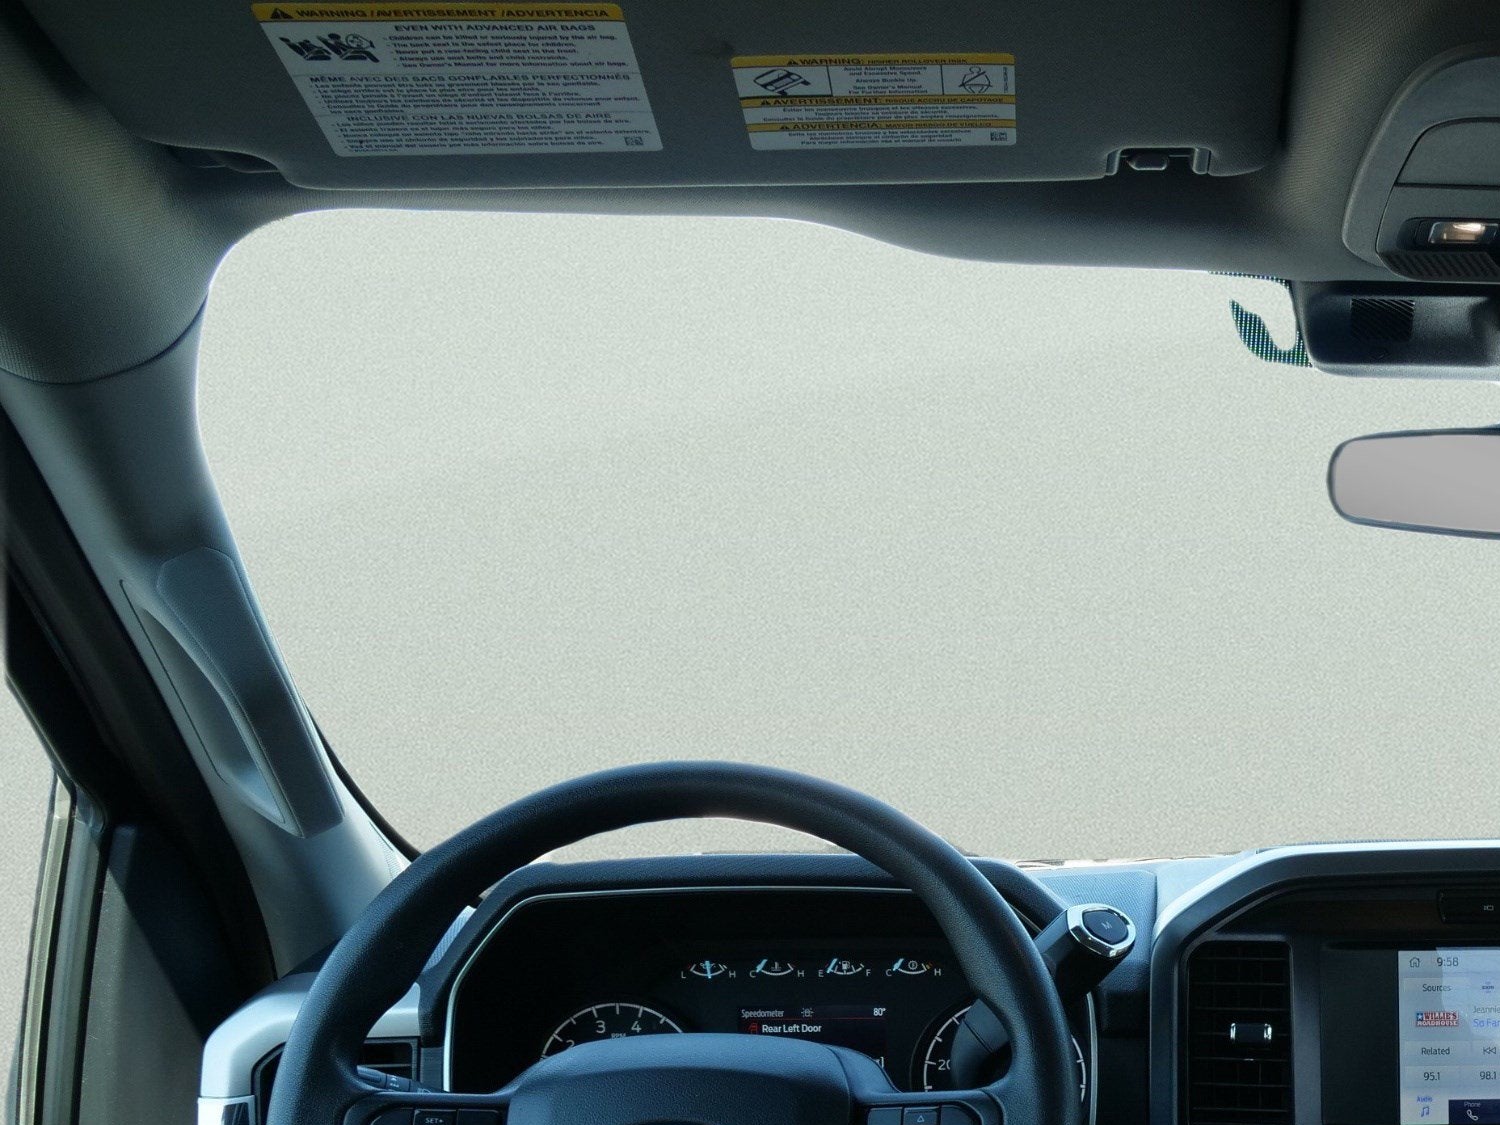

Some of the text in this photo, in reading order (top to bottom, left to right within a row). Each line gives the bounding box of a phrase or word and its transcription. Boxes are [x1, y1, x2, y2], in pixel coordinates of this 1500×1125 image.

[295, 10, 609, 18] WARNING /AVERTISSEMENT /ADVERTENCIA
[1436, 957, 1459, 967] 9:58
[729, 970, 736, 978] H
[1422, 984, 1452, 992] Sources
[741, 1009, 785, 1019] Speedometer
[873, 1007, 886, 1017] 80°
[1473, 1005, 1500, 1014] Jeannie
[1424, 1012, 1457, 1020] WILLIE'S
[595, 1020, 606, 1034] 3
[631, 1020, 642, 1033] 4
[762, 1024, 822, 1033] Rear Left Door
[1421, 1047, 1450, 1056] Related
[1424, 1072, 1441, 1081] 95.1
[1480, 1071, 1497, 1080] 98.1
